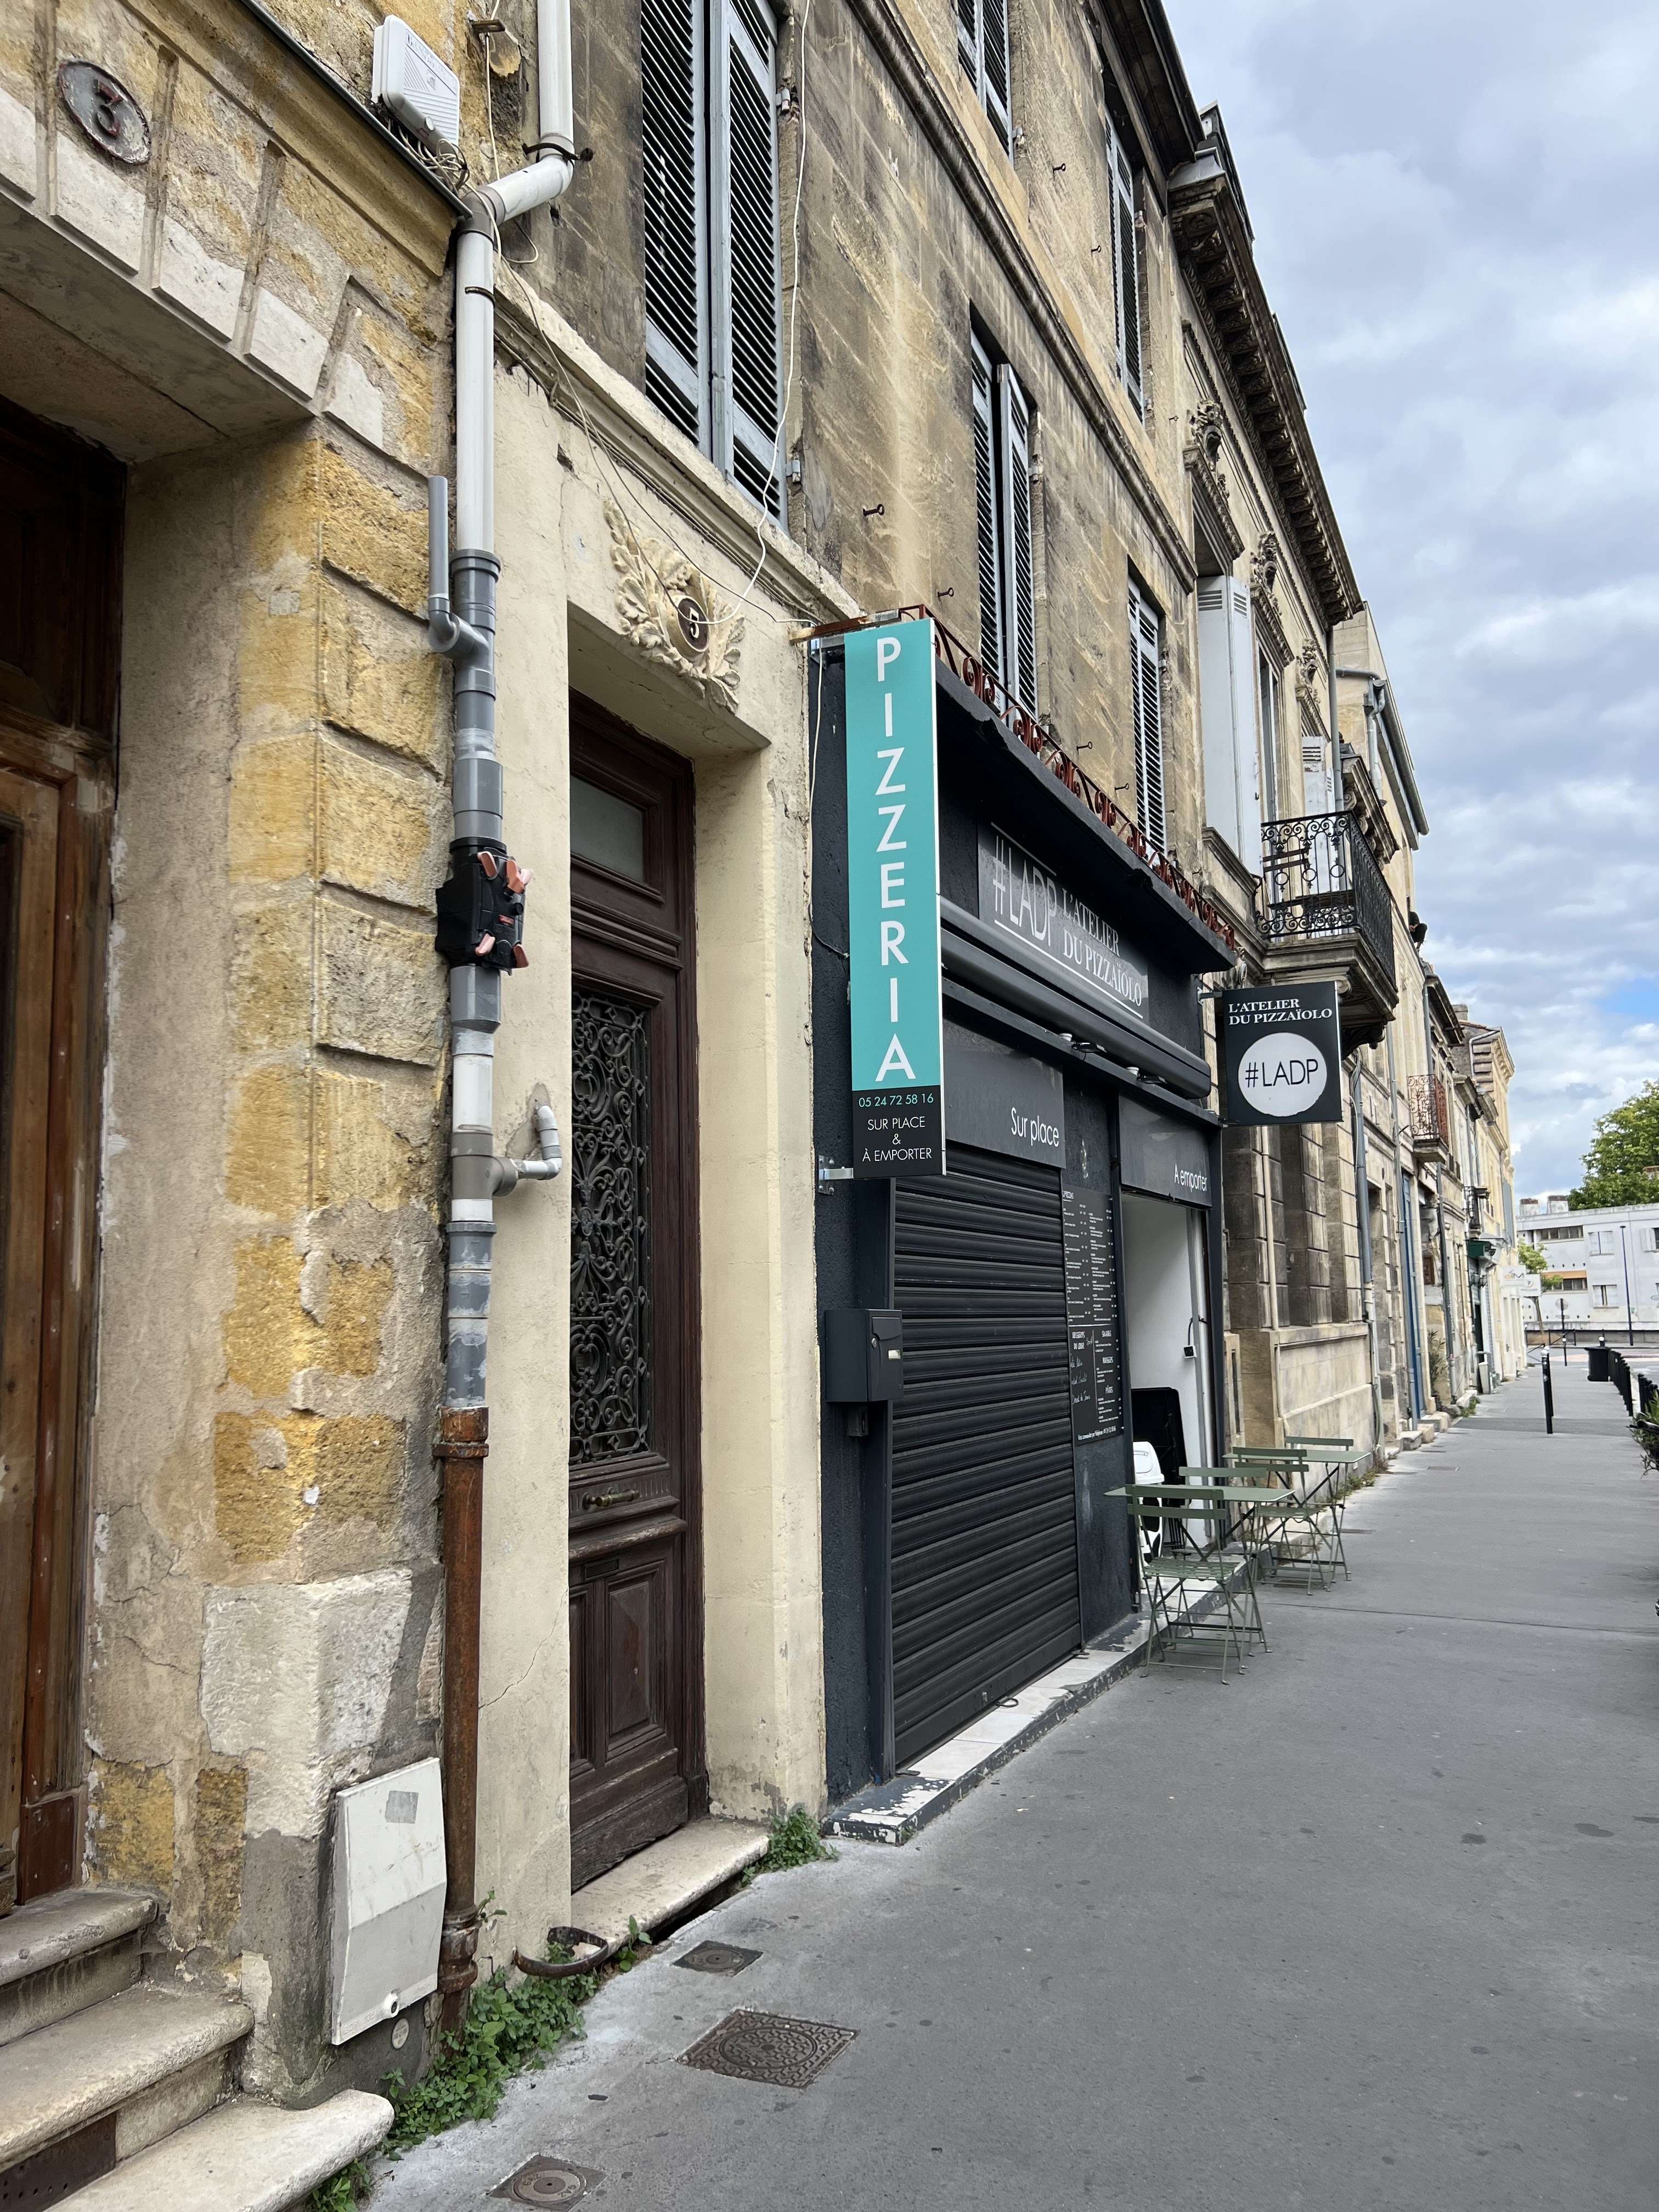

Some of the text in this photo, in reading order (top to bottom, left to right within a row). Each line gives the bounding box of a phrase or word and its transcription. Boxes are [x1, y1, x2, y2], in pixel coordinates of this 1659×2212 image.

[94, 79, 123, 138] 3
[874, 636, 917, 1082] PIZZERIA
[992, 835, 1057, 947] #LADP
[1062, 888, 1120, 957] L'ATELIER
[1063, 928, 1142, 1007] DU PIZZAÏOLO
[1228, 998, 1300, 1013] L'ATELIER
[1228, 1008, 1333, 1025] DU PIZZAÏOLO
[1245, 1058, 1318, 1088] #LADP
[859, 1093, 934, 1107] 05 24 72 58 16
[867, 1116, 926, 1131] SUR PLACE
[1011, 1107, 1059, 1147] Sur place
[892, 1133, 901, 1144] &
[862, 1148, 932, 1162] À EMPORTER
[1175, 1164, 1207, 1193] A emporter
